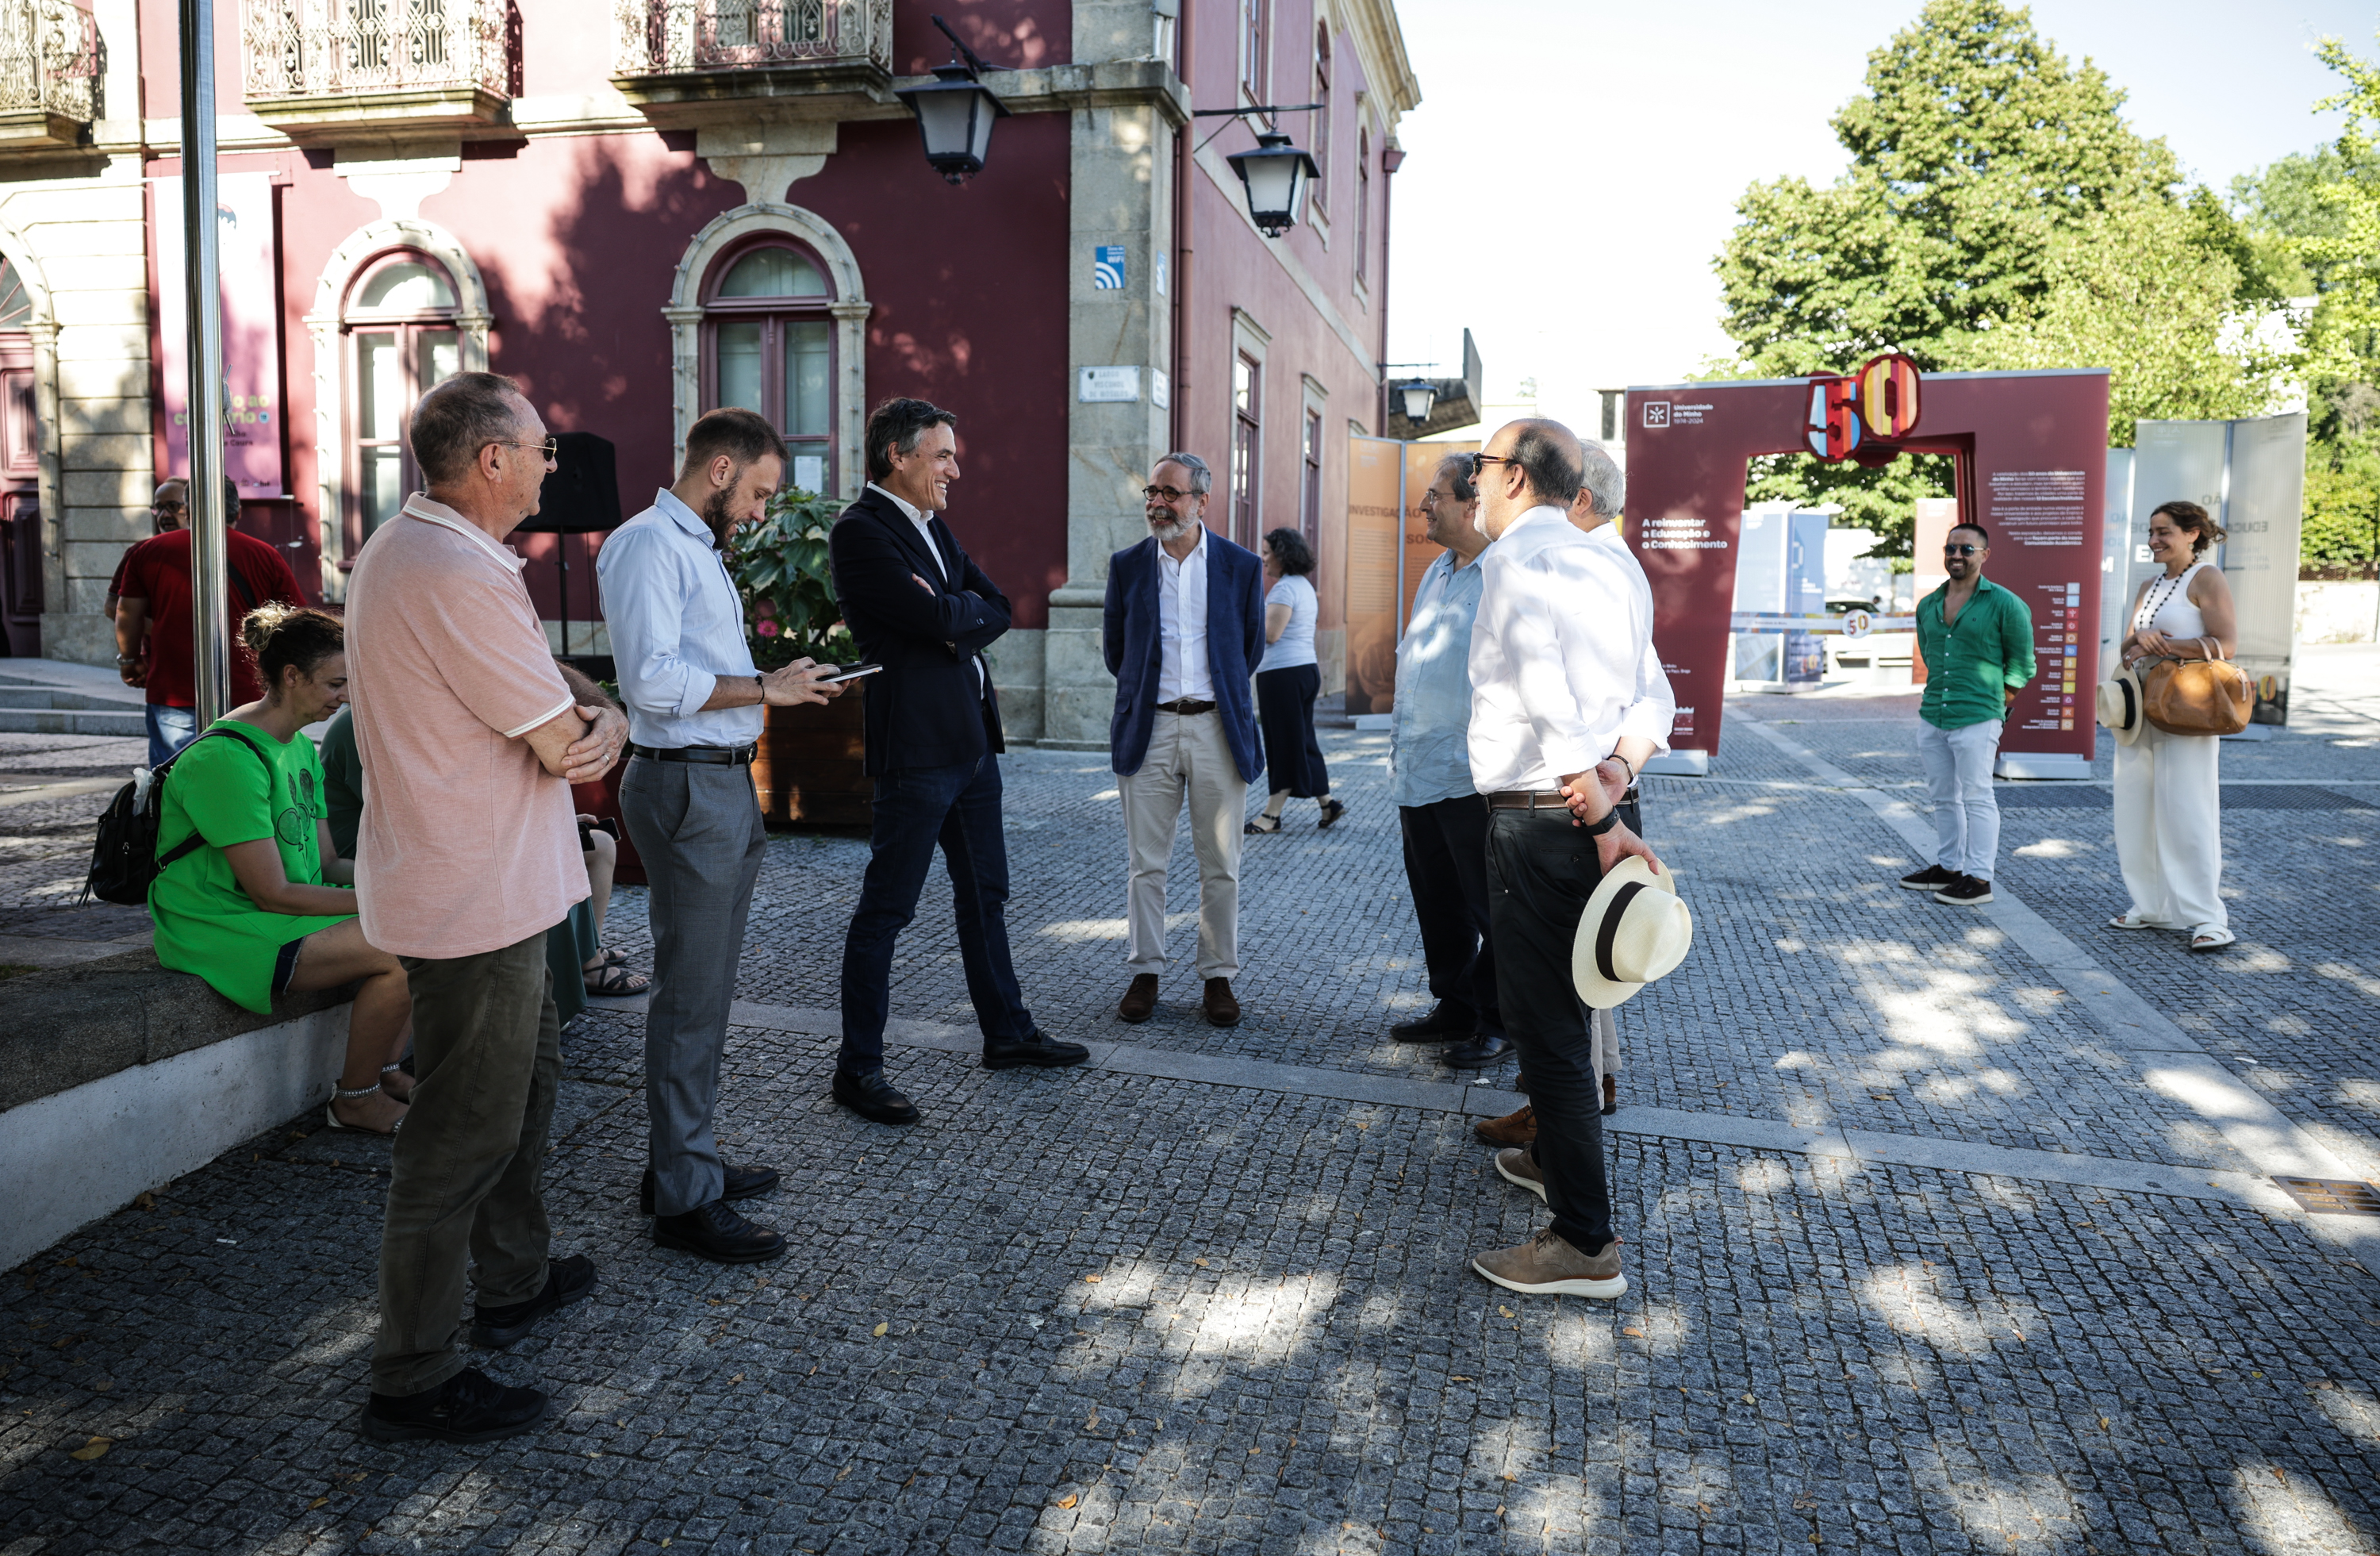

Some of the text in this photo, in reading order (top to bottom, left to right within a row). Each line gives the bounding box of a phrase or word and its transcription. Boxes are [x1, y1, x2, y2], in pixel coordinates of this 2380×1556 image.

[248, 395, 270, 408] ao
[1805, 356, 1919, 461] 50
[1641, 517, 1706, 528] A reinventar
[1650, 528, 1702, 540] Educação
[1650, 540, 1729, 549] Conhecimento
[1849, 615, 1868, 635] 50
